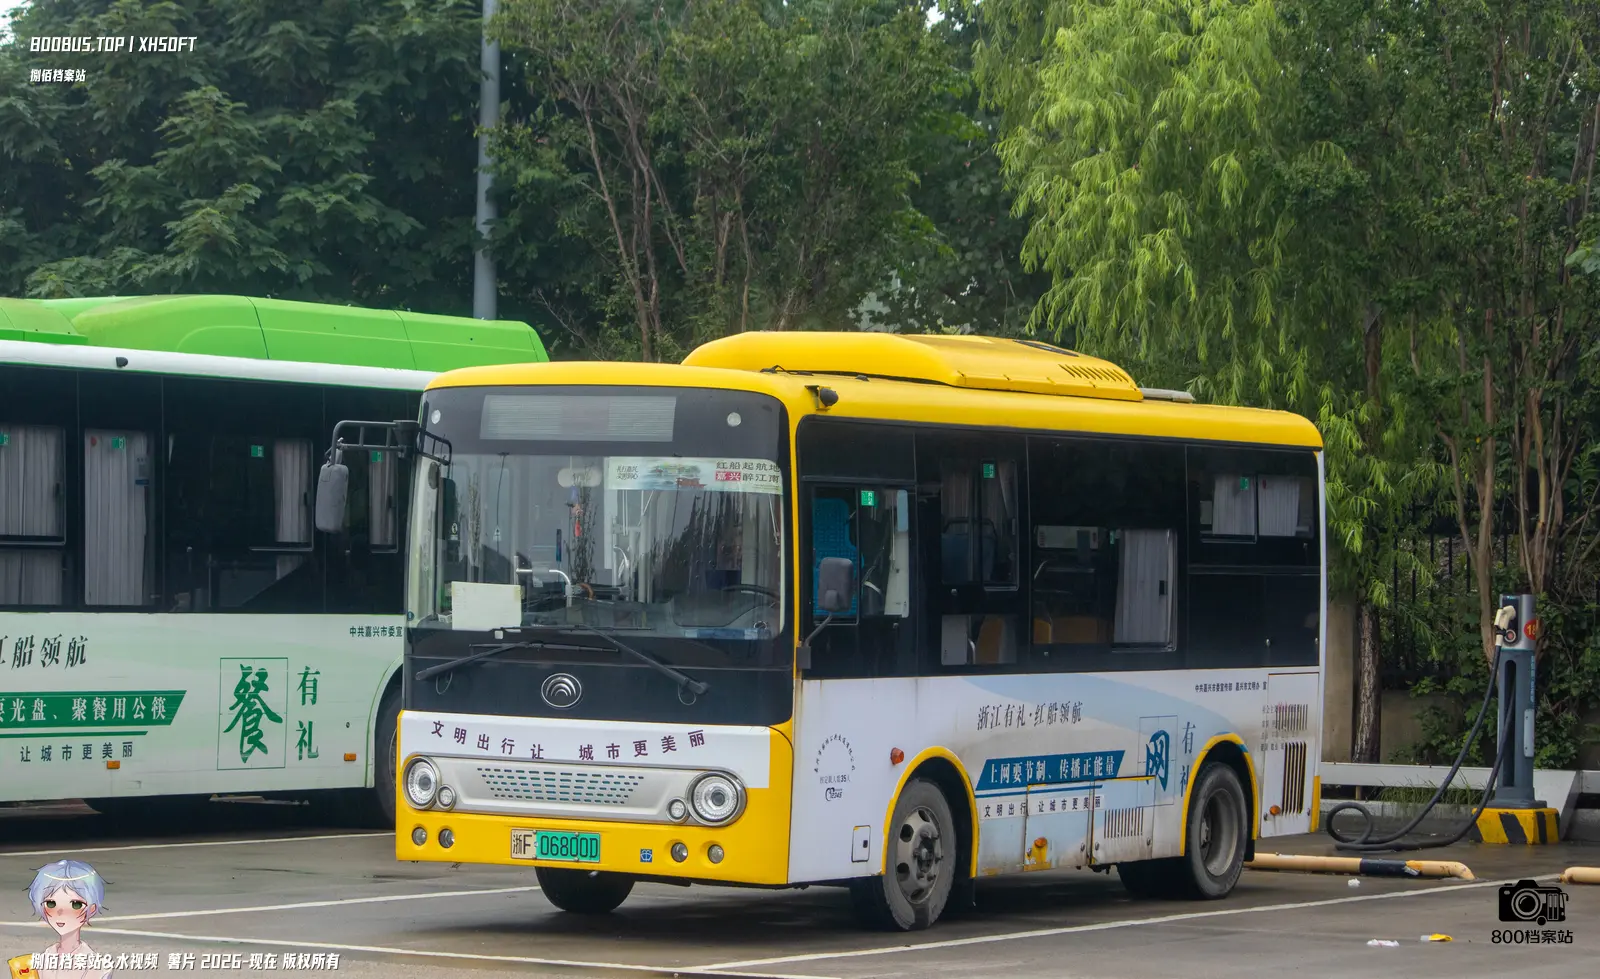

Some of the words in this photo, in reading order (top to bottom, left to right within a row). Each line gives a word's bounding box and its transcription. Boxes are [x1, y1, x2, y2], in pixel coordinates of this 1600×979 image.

[716, 460, 780, 473] 红船起航地
[349, 625, 403, 638] 中共嘉兴市委宣
[223, 663, 283, 763] 餐
[296, 665, 321, 761] 有礼
[20, 741, 133, 763] 让城市更美丽
[1146, 729, 1170, 792] 网
[990, 755, 1115, 785] 上网要节制、传播正能量
[512, 834, 533, 855] 浙F
[540, 835, 599, 859] 06800D
